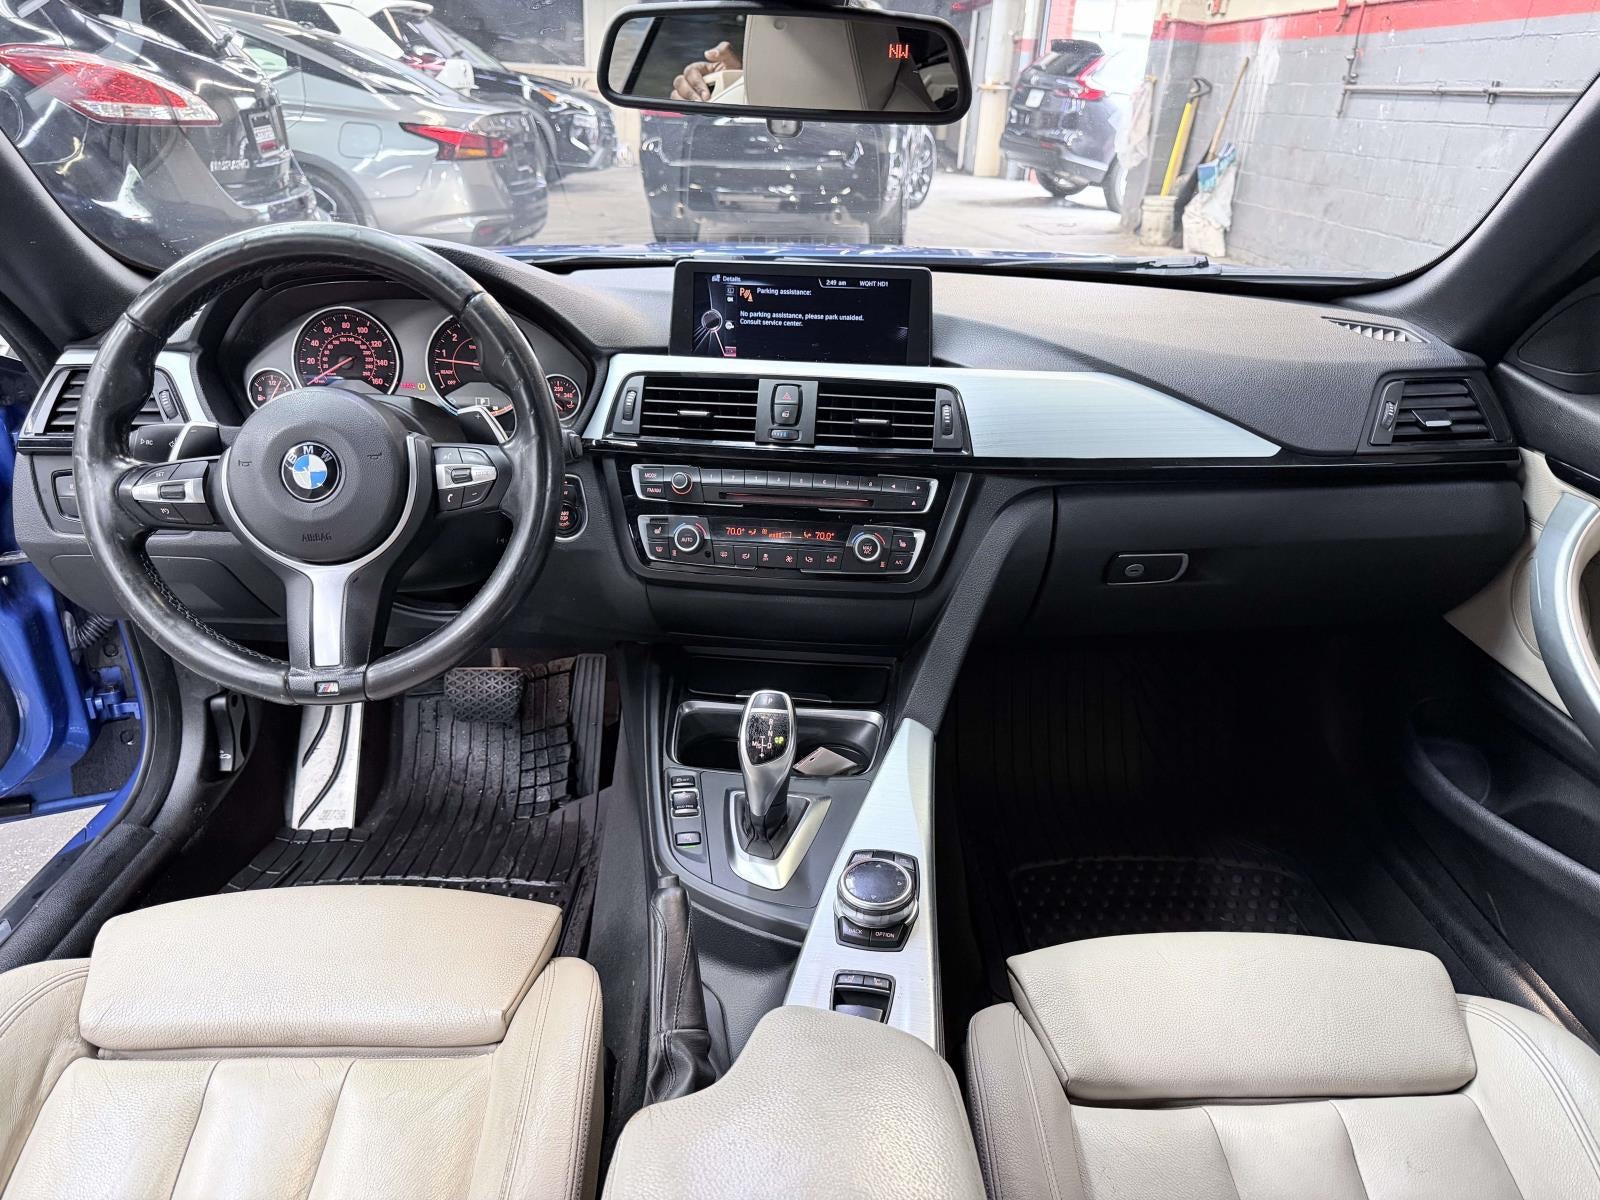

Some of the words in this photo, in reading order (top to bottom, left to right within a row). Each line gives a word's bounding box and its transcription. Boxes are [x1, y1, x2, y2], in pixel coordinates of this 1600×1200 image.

[889, 43, 908, 58] NW
[756, 287, 778, 296] Parking
[780, 288, 812, 296] assistance:
[749, 311, 771, 319] parking
[772, 312, 804, 320] assistance,
[804, 313, 824, 321] please
[357, 326, 368, 334] 100
[452, 333, 458, 342] 2
[307, 357, 316, 365] 20
[287, 445, 333, 464] BMW
[726, 527, 745, 536] 70.0°
[815, 531, 835, 540] 70.0°
[302, 533, 332, 542] AIRBAG
